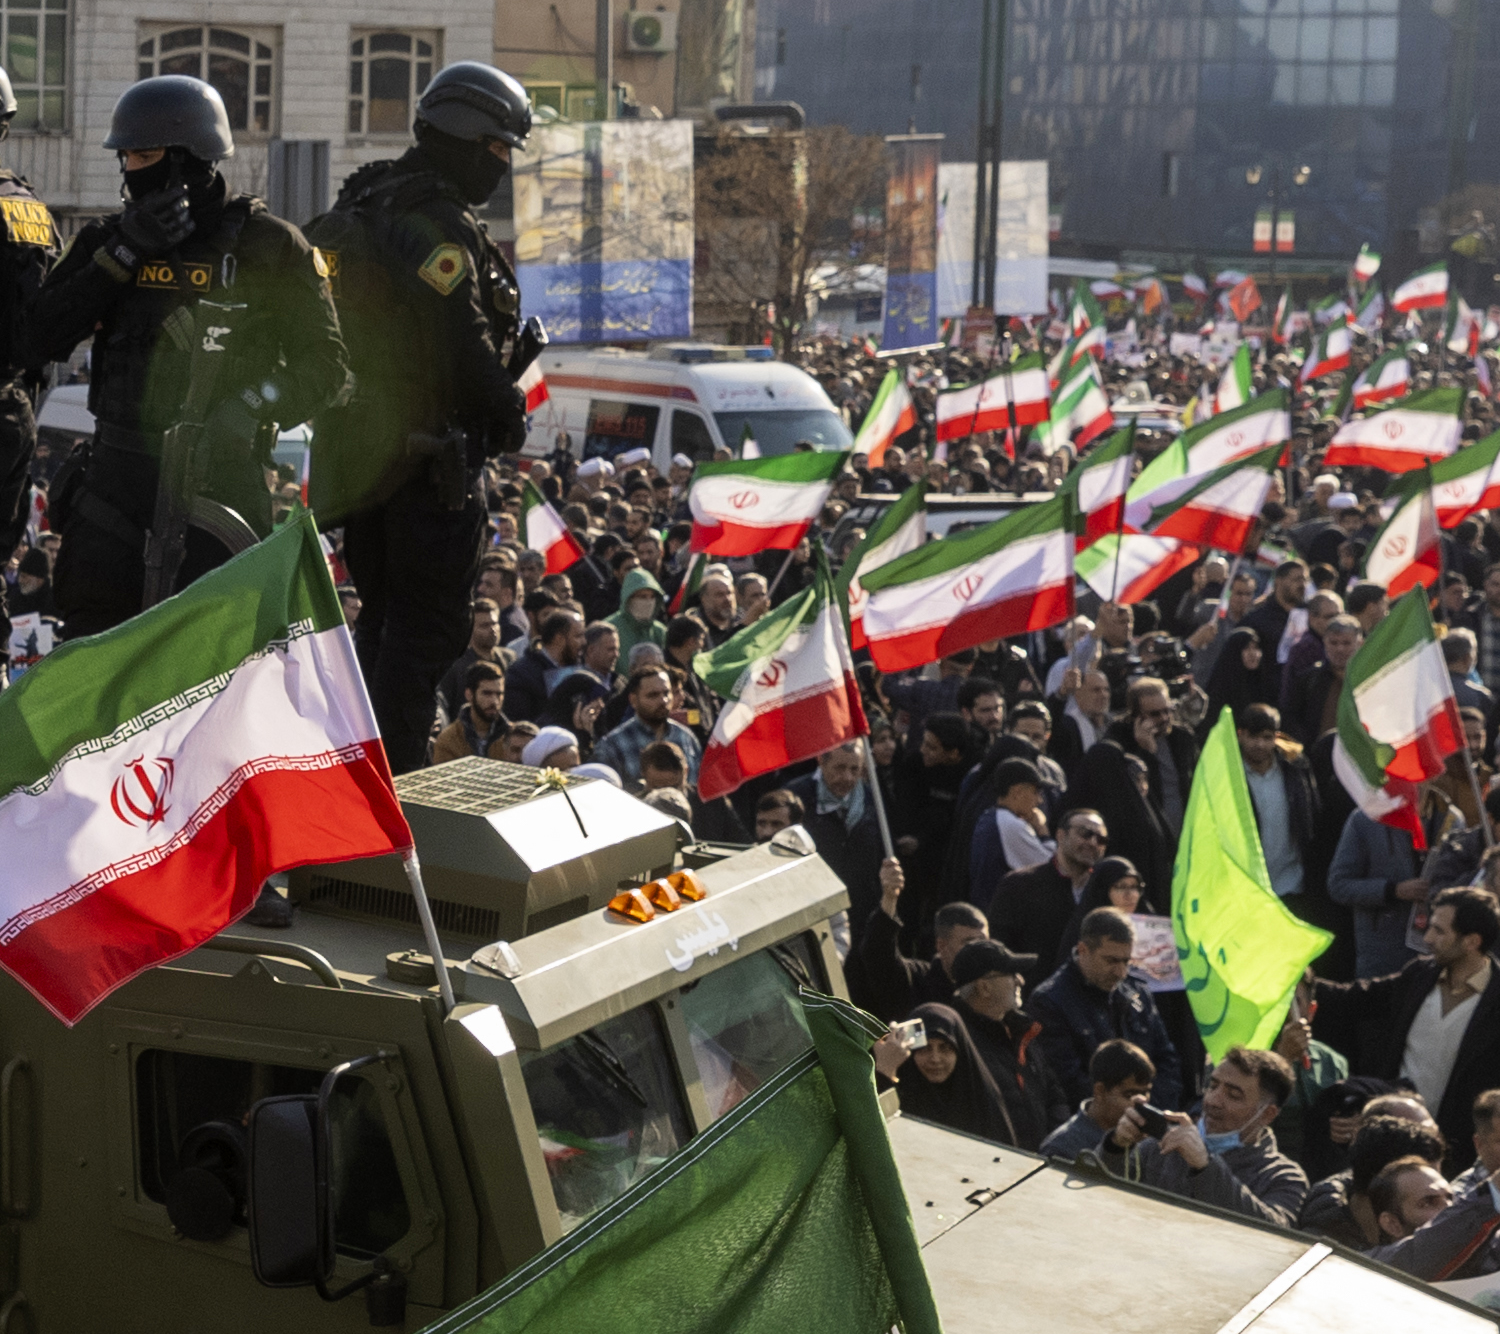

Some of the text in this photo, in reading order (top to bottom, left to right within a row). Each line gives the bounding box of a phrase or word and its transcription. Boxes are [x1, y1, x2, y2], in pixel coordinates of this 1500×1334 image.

[2, 201, 51, 225] POLICE
[12, 221, 50, 243] NOPO
[141, 265, 208, 286] NOO
[664, 905, 739, 972] پلیس
